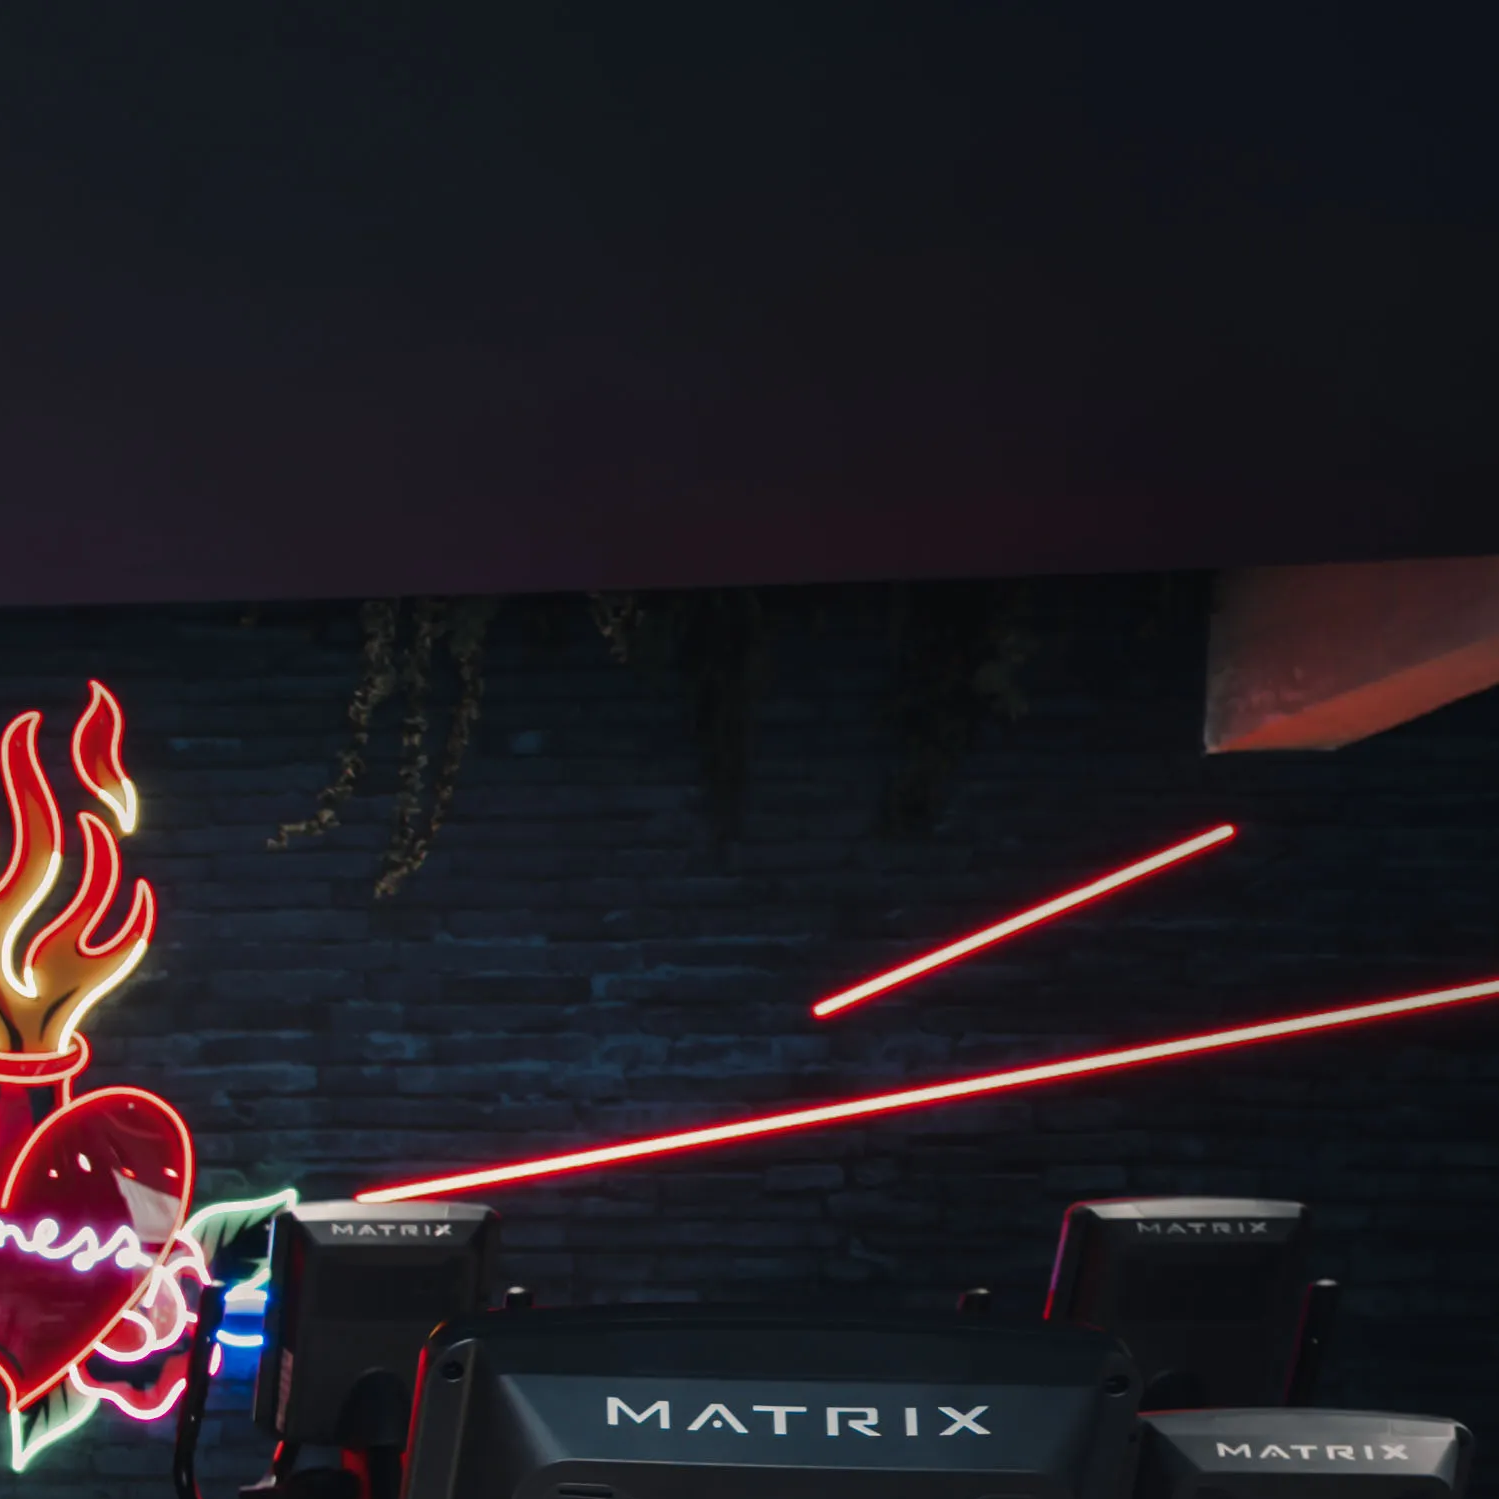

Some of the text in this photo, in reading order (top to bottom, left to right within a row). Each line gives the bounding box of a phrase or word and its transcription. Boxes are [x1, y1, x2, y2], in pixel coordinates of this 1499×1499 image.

[331, 1223, 452, 1237] MATRIX
[1136, 1221, 1268, 1234] MATRIX
[606, 1396, 992, 1437] MATRIX
[1216, 1442, 1409, 1461] MATRIX
